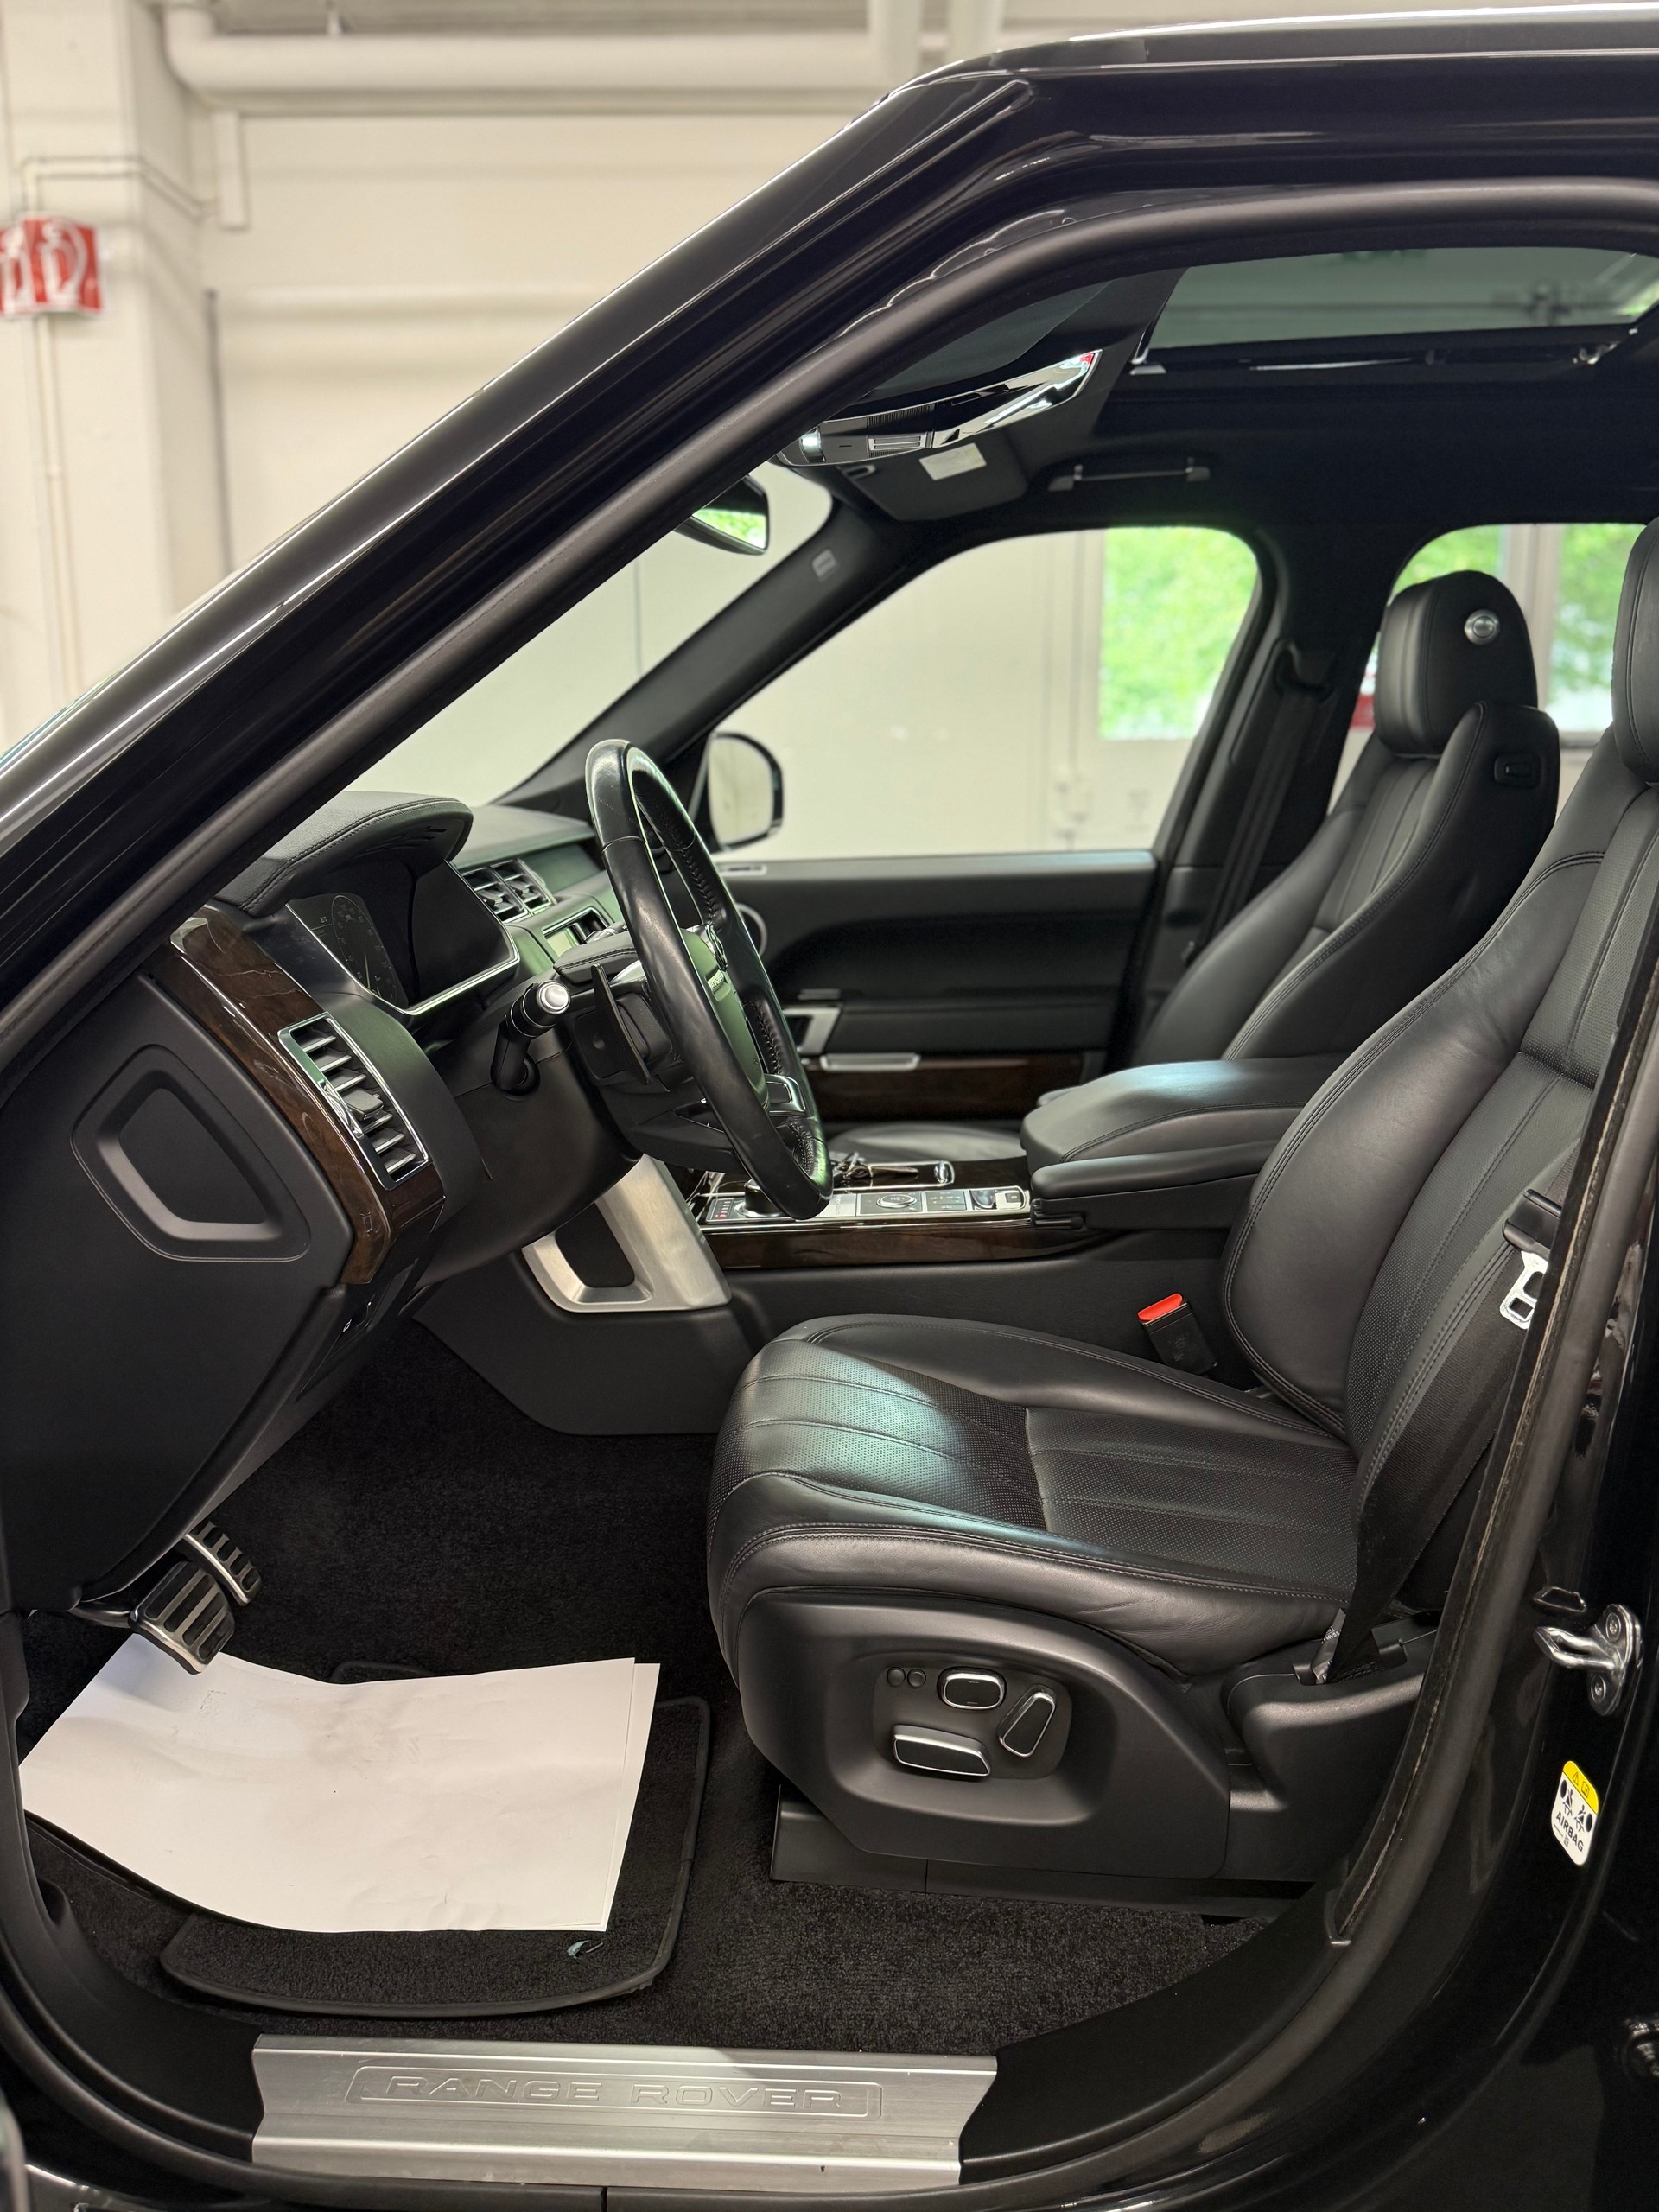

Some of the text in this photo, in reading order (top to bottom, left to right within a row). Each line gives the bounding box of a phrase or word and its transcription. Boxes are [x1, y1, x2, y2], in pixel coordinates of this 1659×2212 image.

[1555, 1811, 1584, 1853] AIRBAG
[386, 2075, 843, 2109] RANGE ROVER
